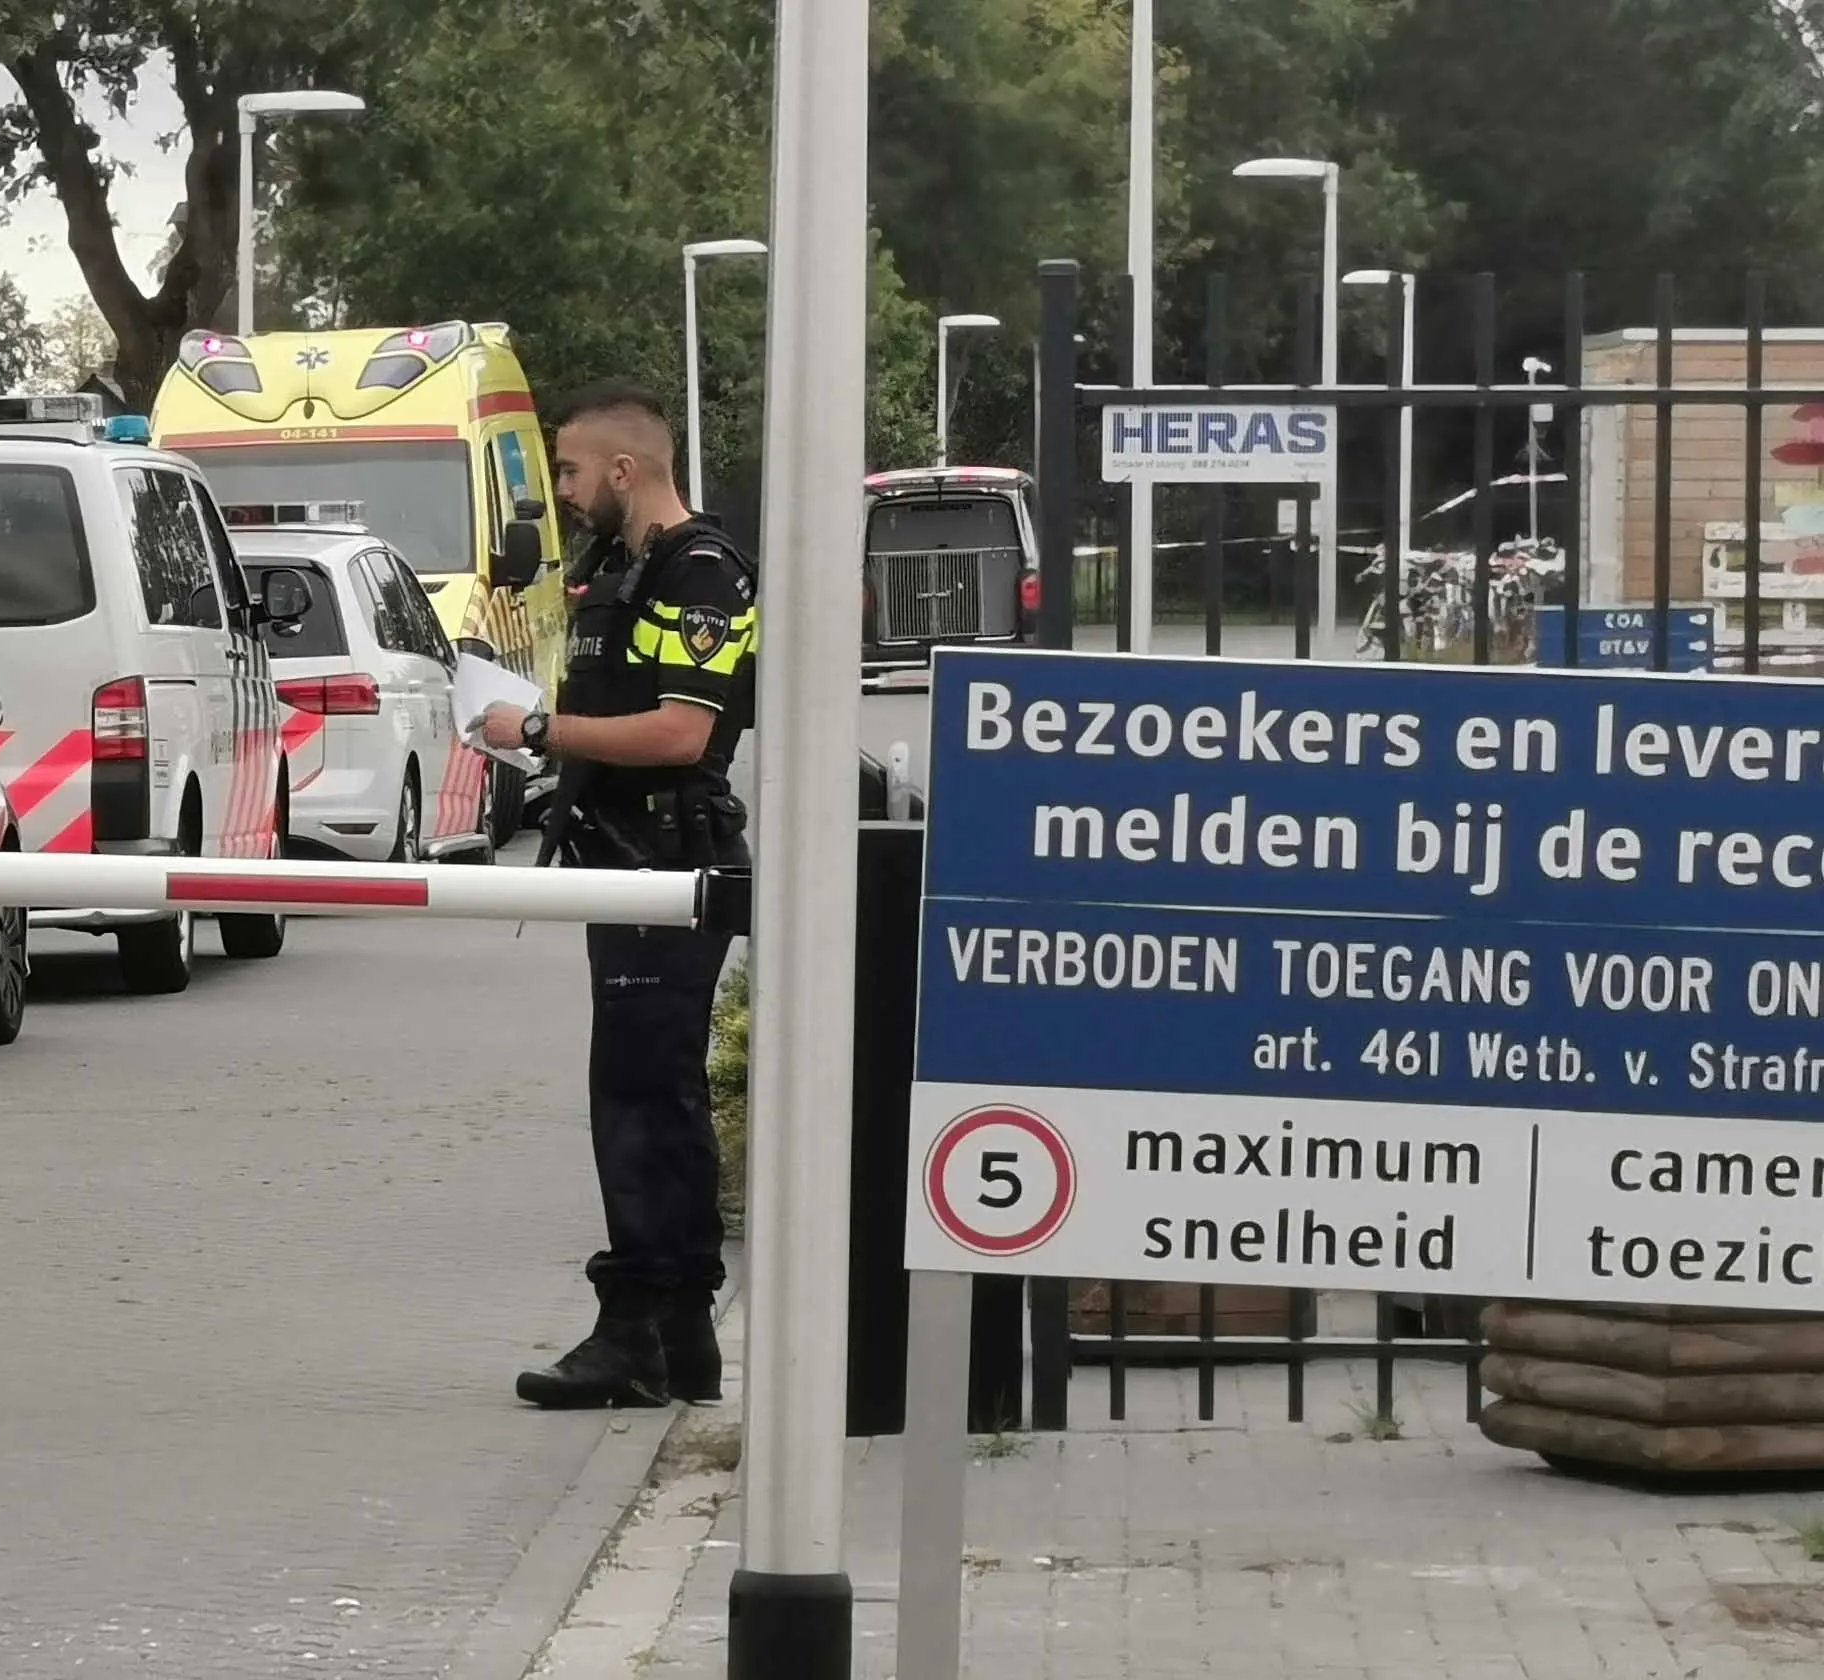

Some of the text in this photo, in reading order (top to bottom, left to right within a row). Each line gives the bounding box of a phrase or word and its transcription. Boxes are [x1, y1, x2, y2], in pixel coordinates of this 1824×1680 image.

[1113, 411, 1327, 454] HERAS
[966, 682, 1824, 782] Bezoekers en lever
[1033, 792, 1824, 896] melden bij de rec
[946, 926, 1237, 993] VERBODEN
[1272, 940, 1531, 1007] TOEGANG
[1565, 951, 1714, 1013] VOOR
[1253, 1026, 1332, 1071] art.
[1359, 1029, 1440, 1076] 461
[1468, 1031, 1596, 1084] Wetb.
[1624, 1050, 1659, 1086] v.
[977, 1150, 1023, 1209] 5
[1125, 1119, 1480, 1185] maximum
[1143, 1207, 1454, 1270] snelheid
[1586, 1225, 1814, 1285] toezic
